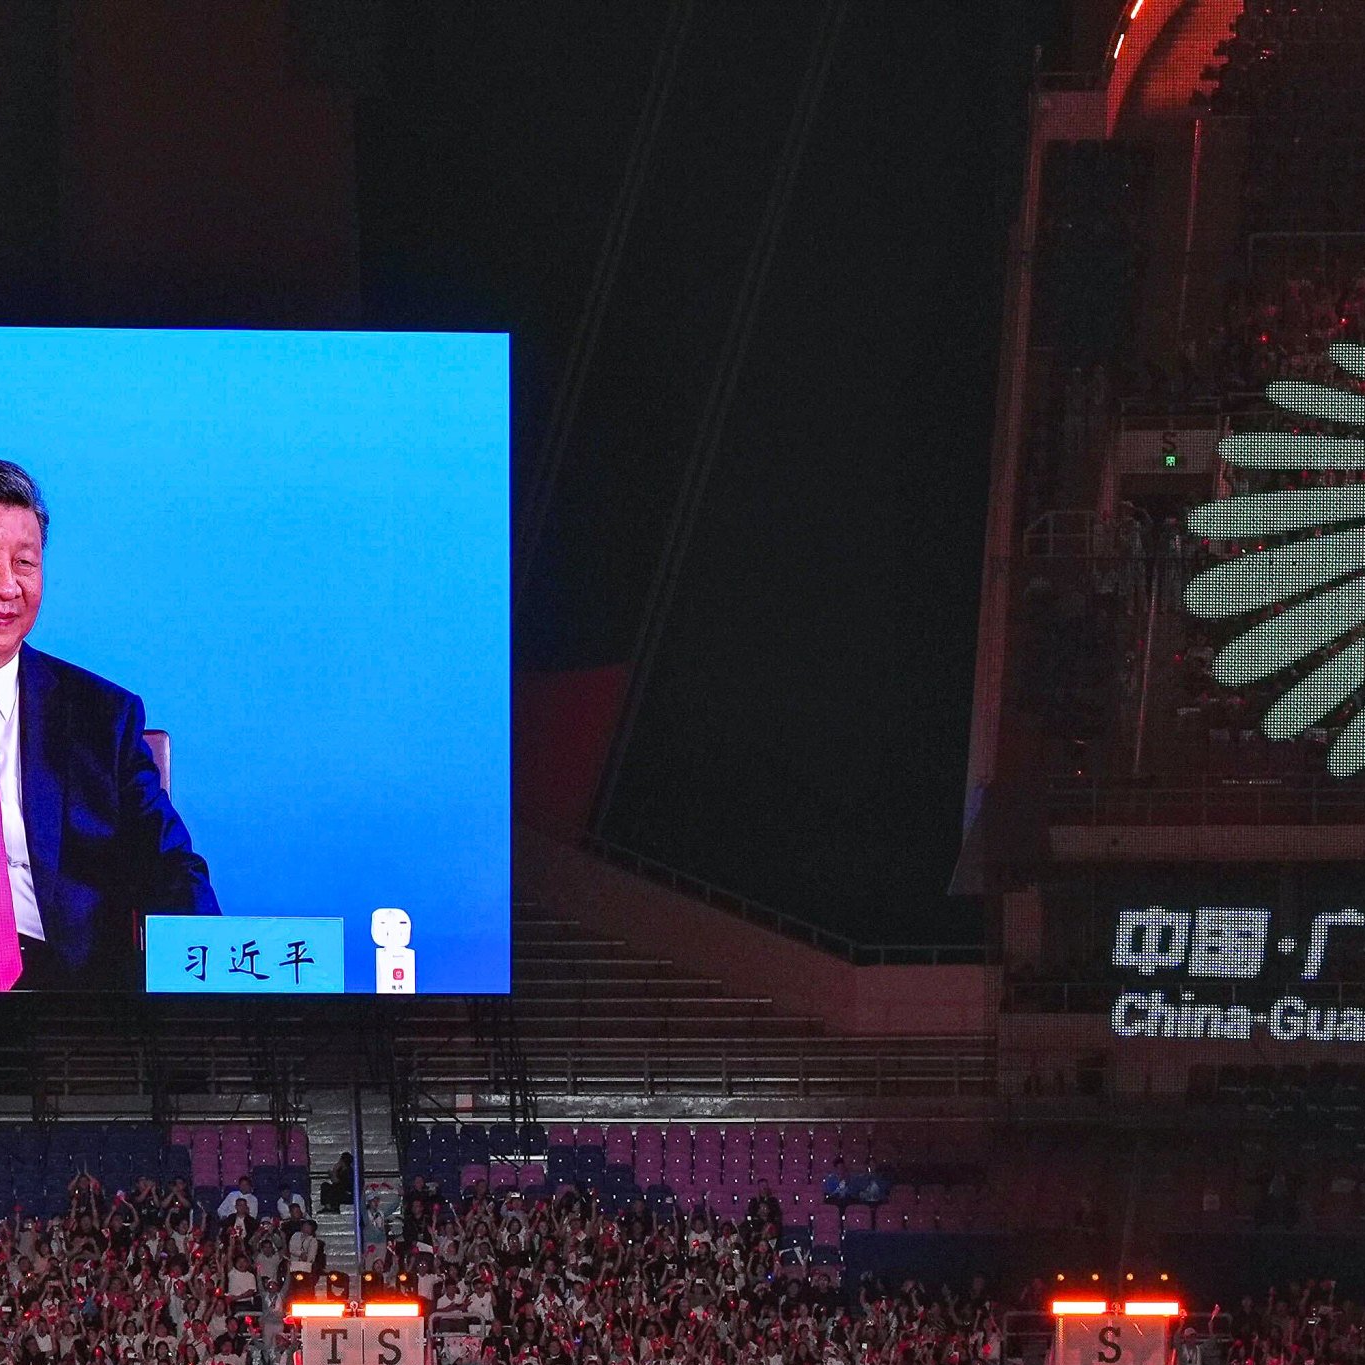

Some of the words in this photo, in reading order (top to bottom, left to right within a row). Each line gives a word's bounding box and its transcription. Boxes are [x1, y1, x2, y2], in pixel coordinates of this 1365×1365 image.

[184, 942, 315, 984] 习近平
[320, 1329, 348, 1365] T
[378, 1329, 402, 1365] S
[1097, 1326, 1122, 1363] S
